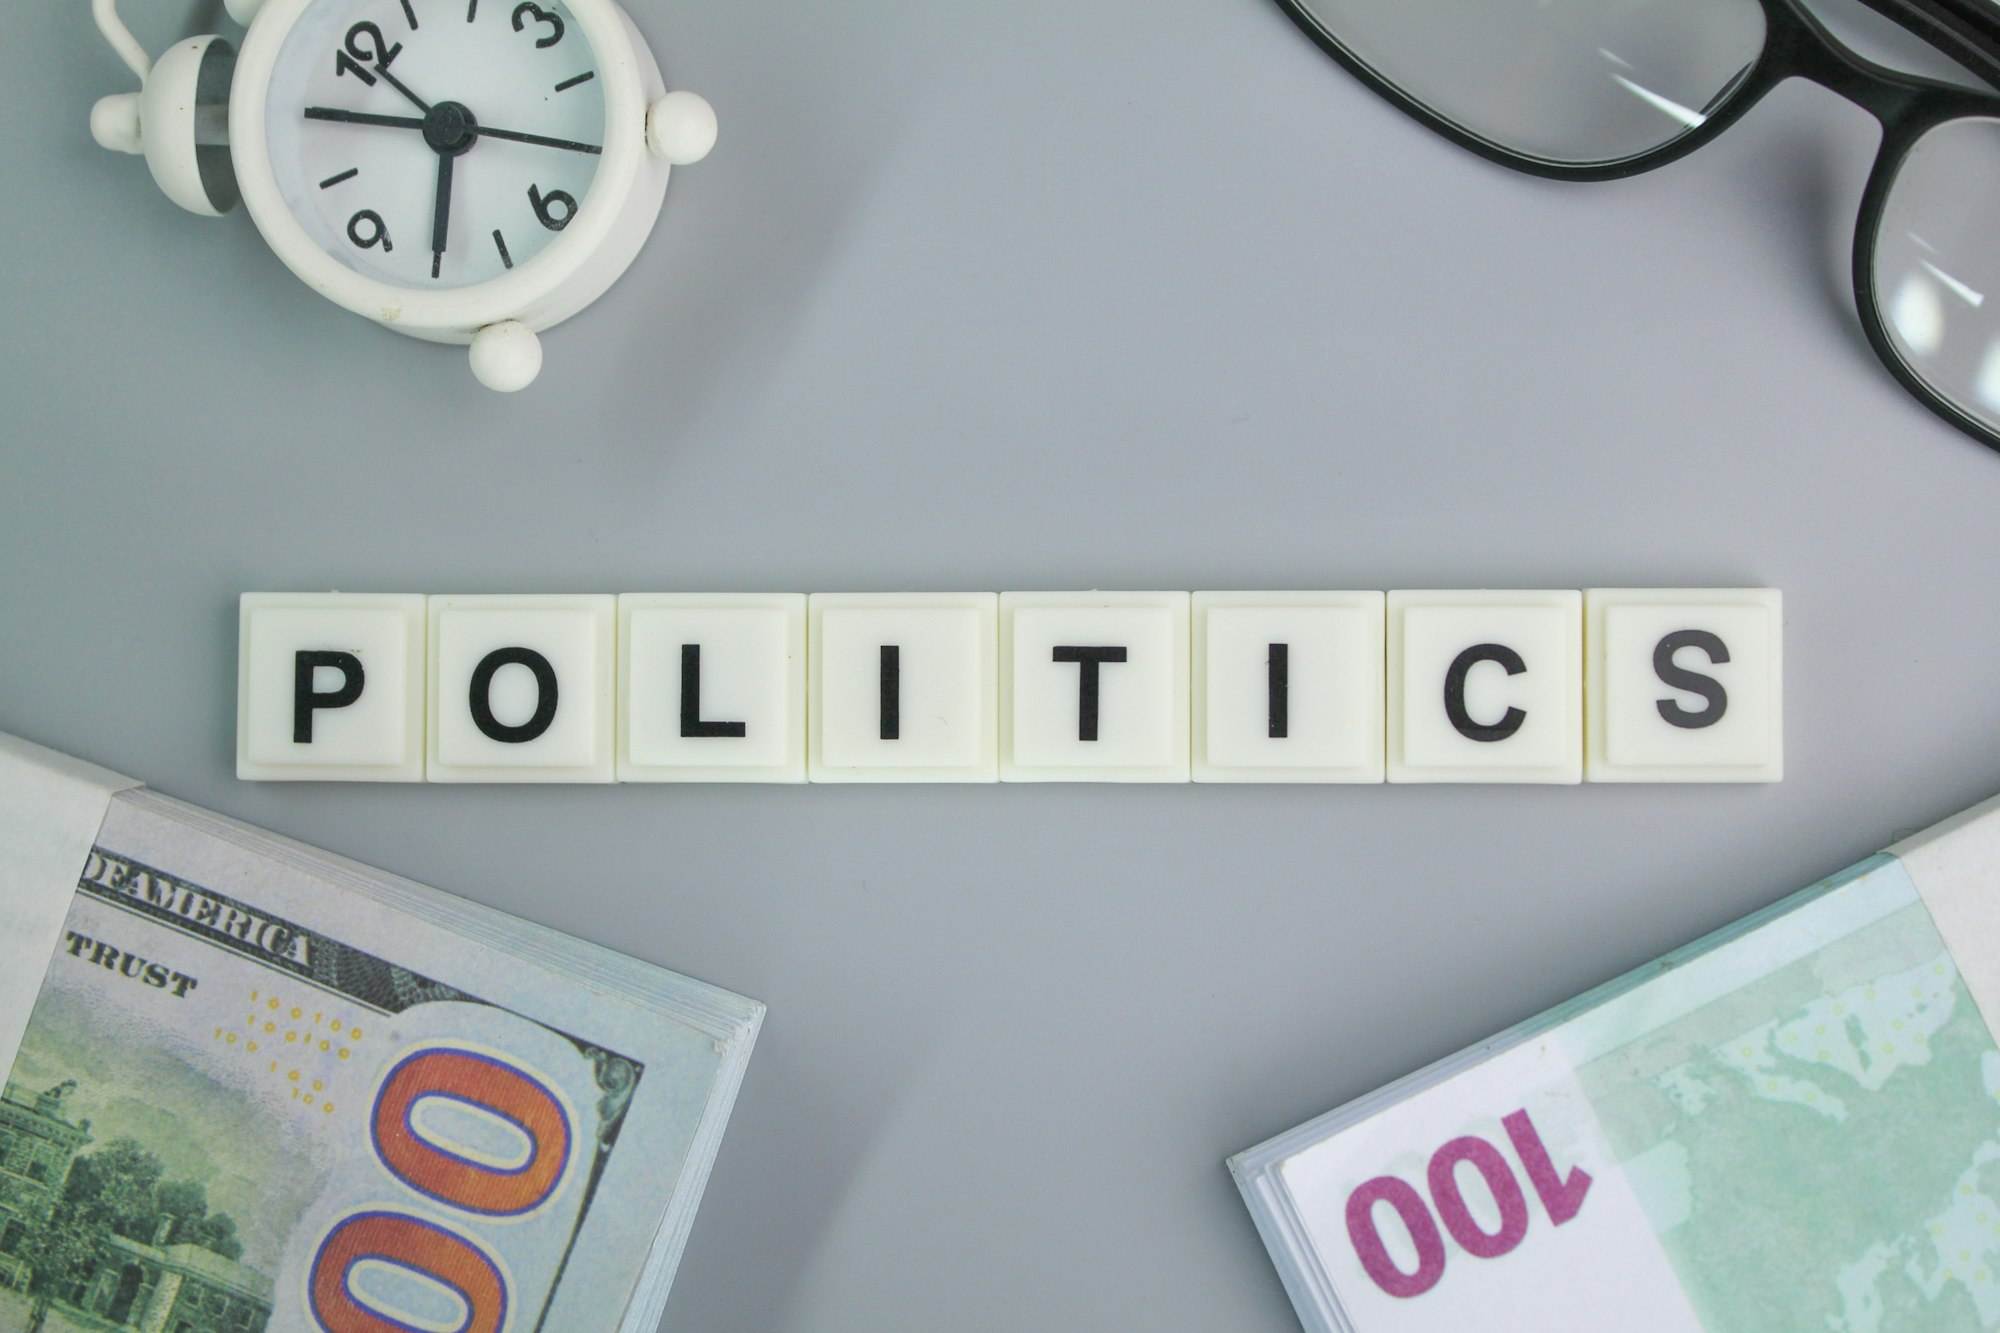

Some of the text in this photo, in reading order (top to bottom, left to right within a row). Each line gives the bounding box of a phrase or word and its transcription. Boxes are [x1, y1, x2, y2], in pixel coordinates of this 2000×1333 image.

[336, 20, 403, 86] 12
[512, 1, 565, 49] 3
[347, 208, 393, 252] 9
[527, 183, 578, 231] 6
[293, 628, 1731, 744] POLITICS
[66, 930, 198, 999] TRUST
[1345, 1108, 1593, 1299] 100
